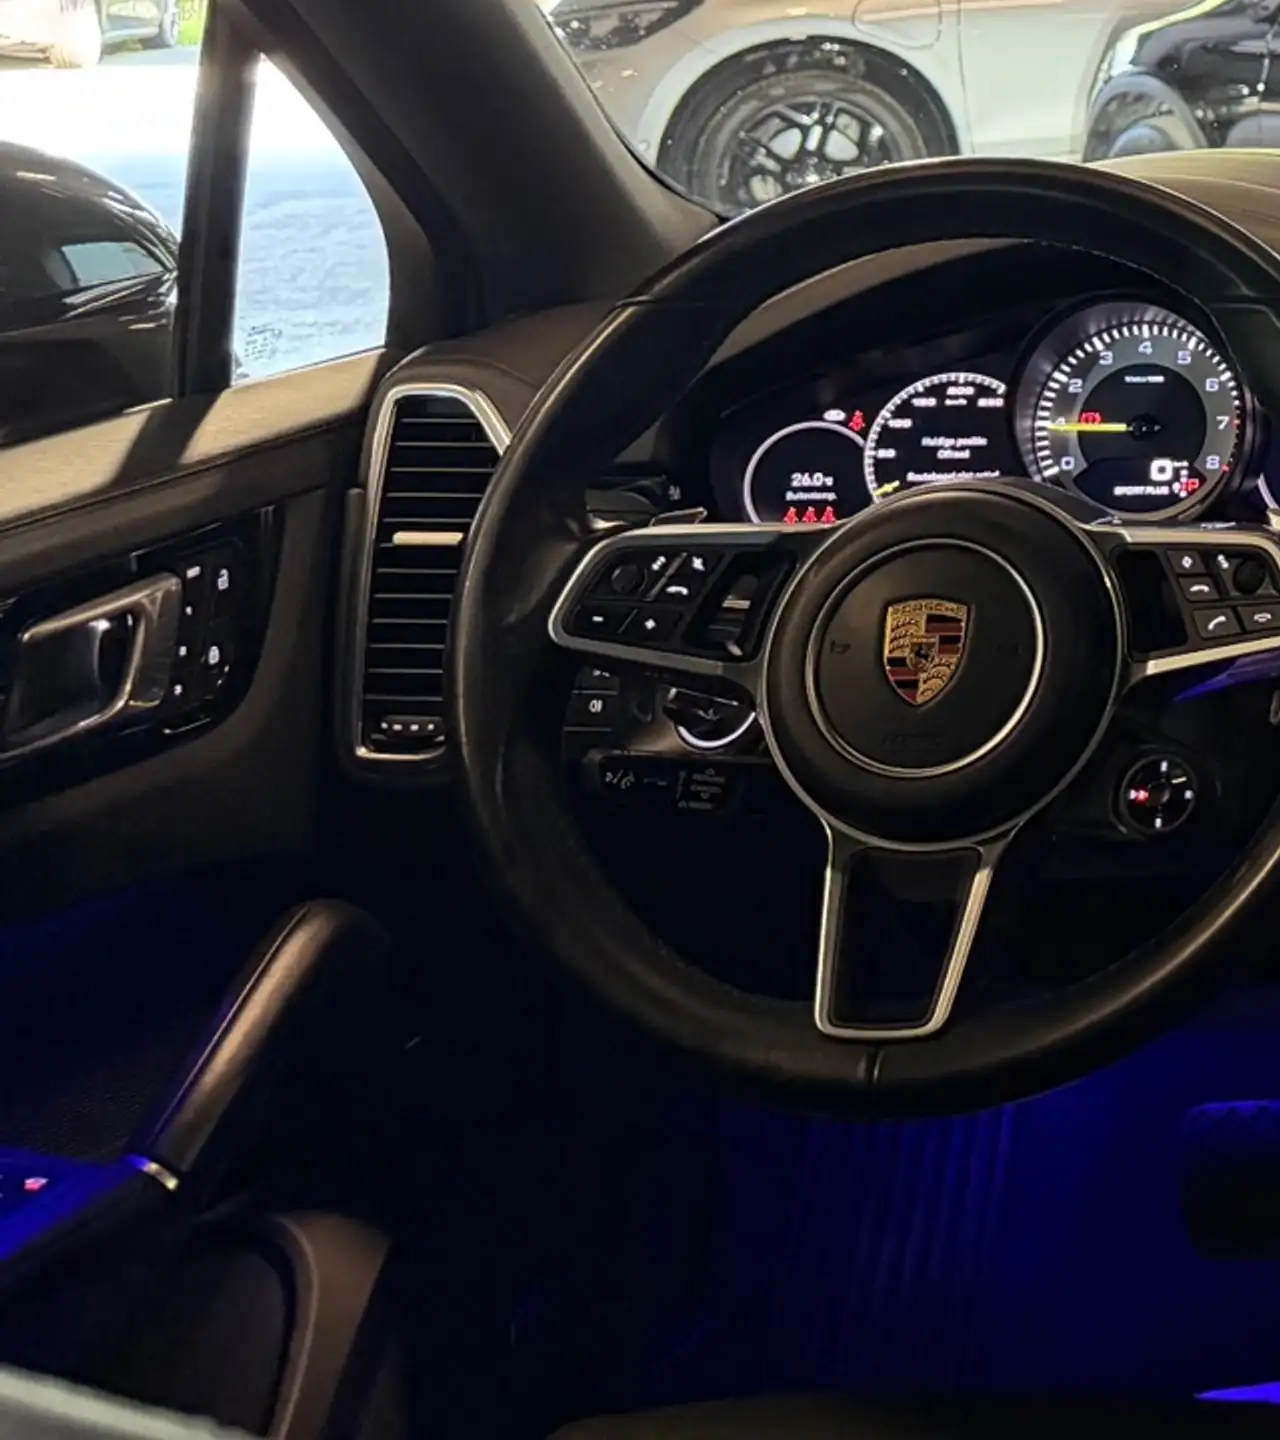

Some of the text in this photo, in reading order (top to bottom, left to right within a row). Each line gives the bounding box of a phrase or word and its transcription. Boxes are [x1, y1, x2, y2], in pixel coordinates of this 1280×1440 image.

[1138, 341, 1153, 355] 4
[1098, 351, 1114, 365] 3
[1177, 351, 1192, 365] 5
[1067, 378, 1083, 393] 2
[1205, 378, 1220, 392] 6
[1215, 416, 1230, 430] 7
[1060, 457, 1075, 470] 0
[1205, 456, 1220, 469] 8
[1150, 459, 1173, 481] 0
